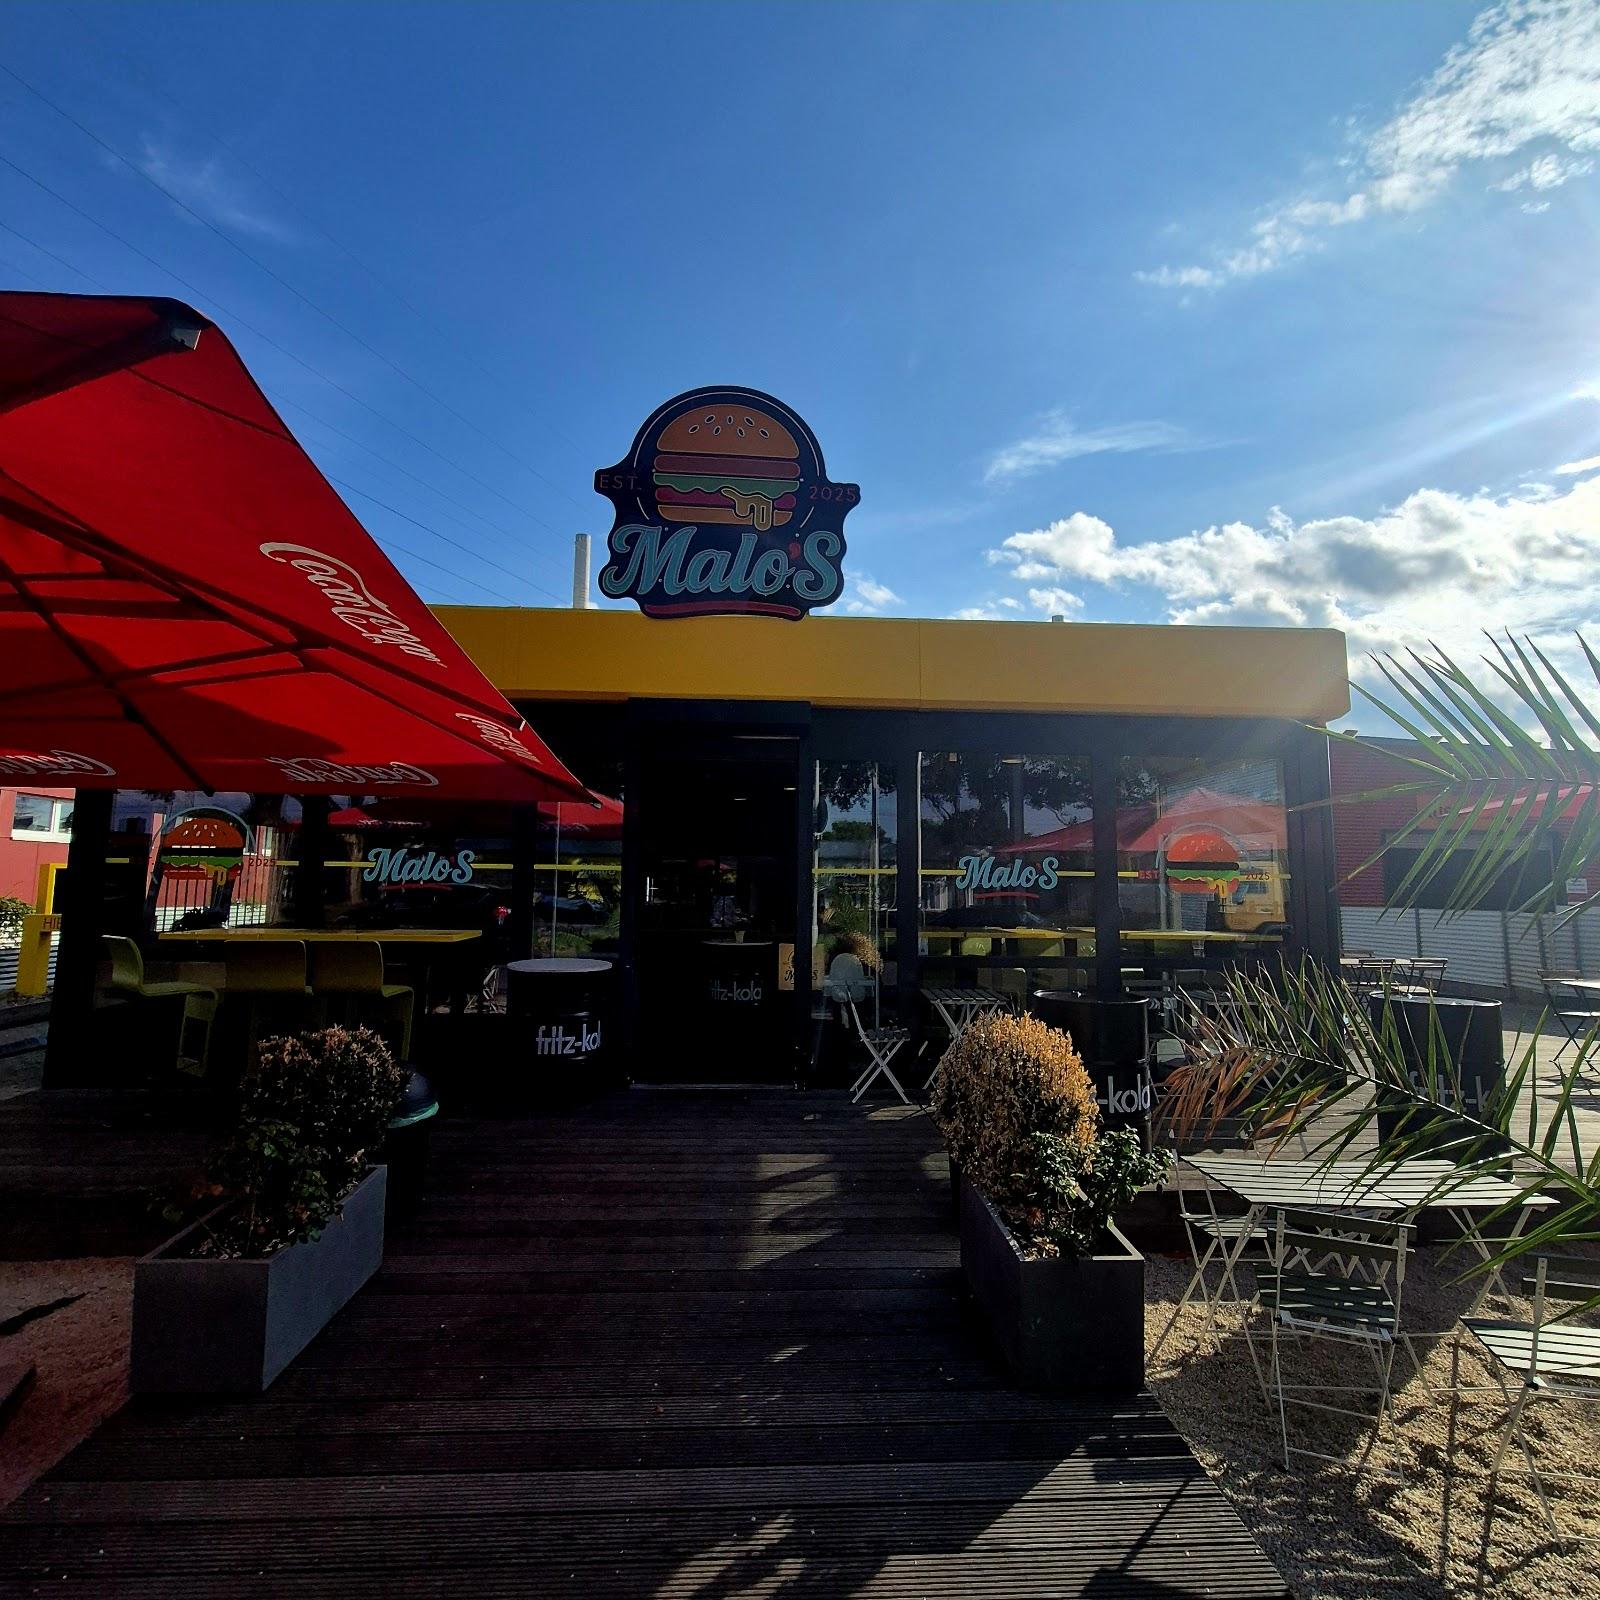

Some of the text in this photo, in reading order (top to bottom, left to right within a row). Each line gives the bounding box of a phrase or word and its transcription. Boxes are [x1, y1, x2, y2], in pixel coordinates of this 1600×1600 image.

[598, 474, 641, 491] EST.
[809, 485, 858, 503] 2025
[259, 541, 447, 669] Coca-Cola
[248, 858, 276, 867] 2025
[1245, 872, 1270, 881] 2025
